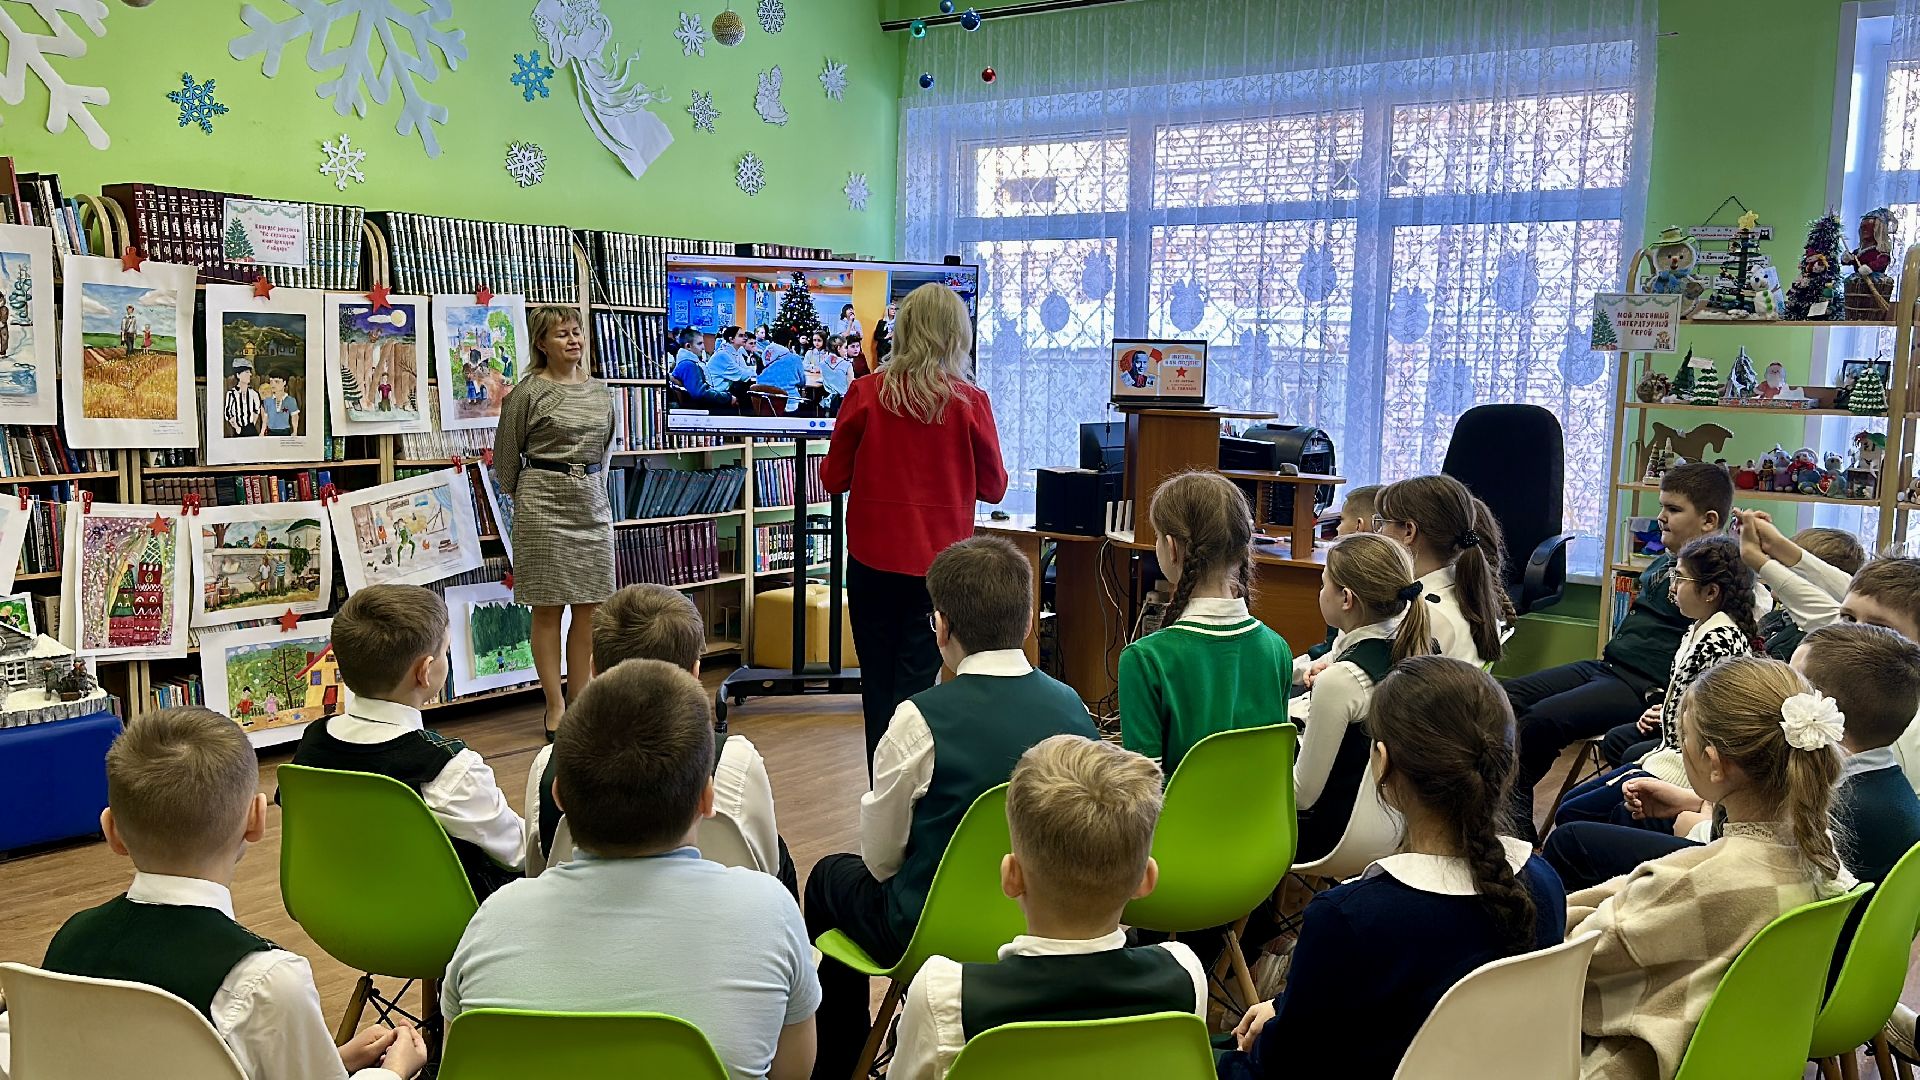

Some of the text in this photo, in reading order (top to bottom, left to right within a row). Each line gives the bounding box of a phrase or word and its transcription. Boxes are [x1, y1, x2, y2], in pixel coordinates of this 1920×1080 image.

[1616, 311, 1670, 320] МОЙ ЛЮБИМЫЙ
[1616, 319, 1669, 328] ЛИТЕРАТУРНЫЙ
[1630, 328, 1653, 336] ГЕРОЙ
